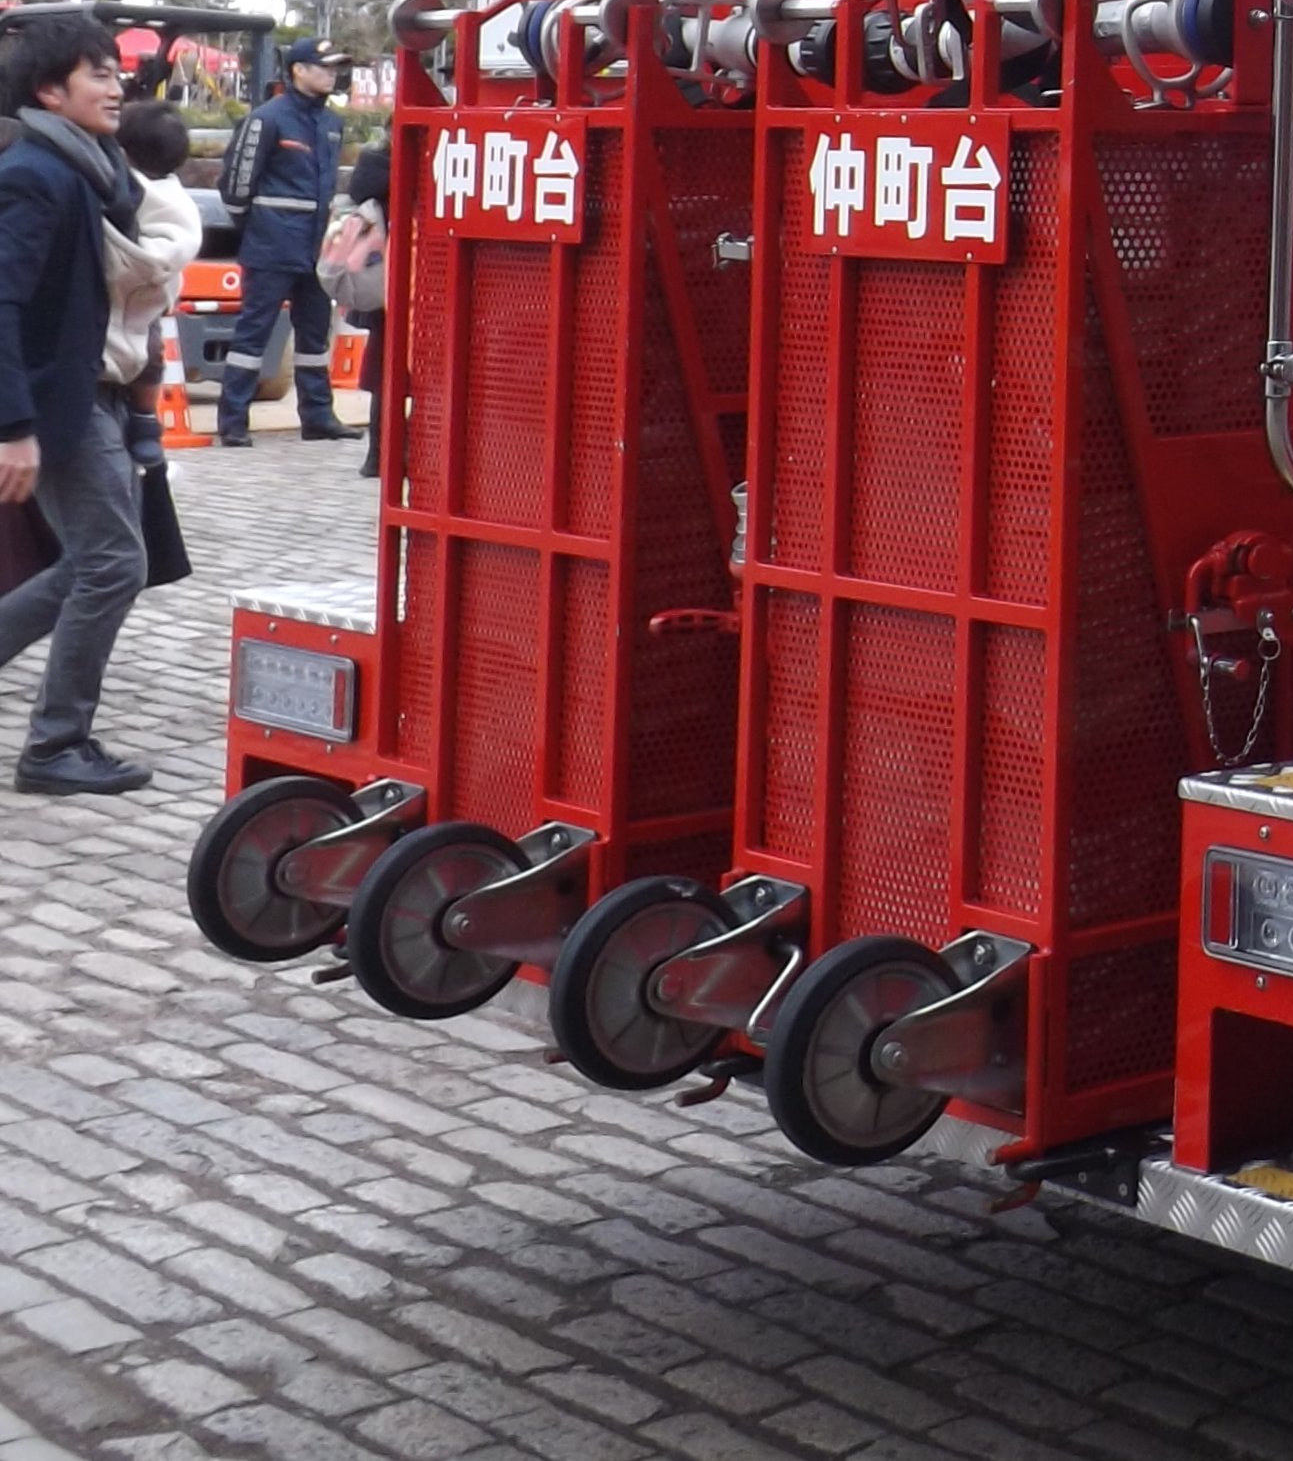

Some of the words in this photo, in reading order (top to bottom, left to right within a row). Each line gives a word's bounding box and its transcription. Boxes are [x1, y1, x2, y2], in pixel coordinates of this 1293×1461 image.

[433, 129, 580, 225] 仲町台
[809, 133, 1001, 242] 仲町台
